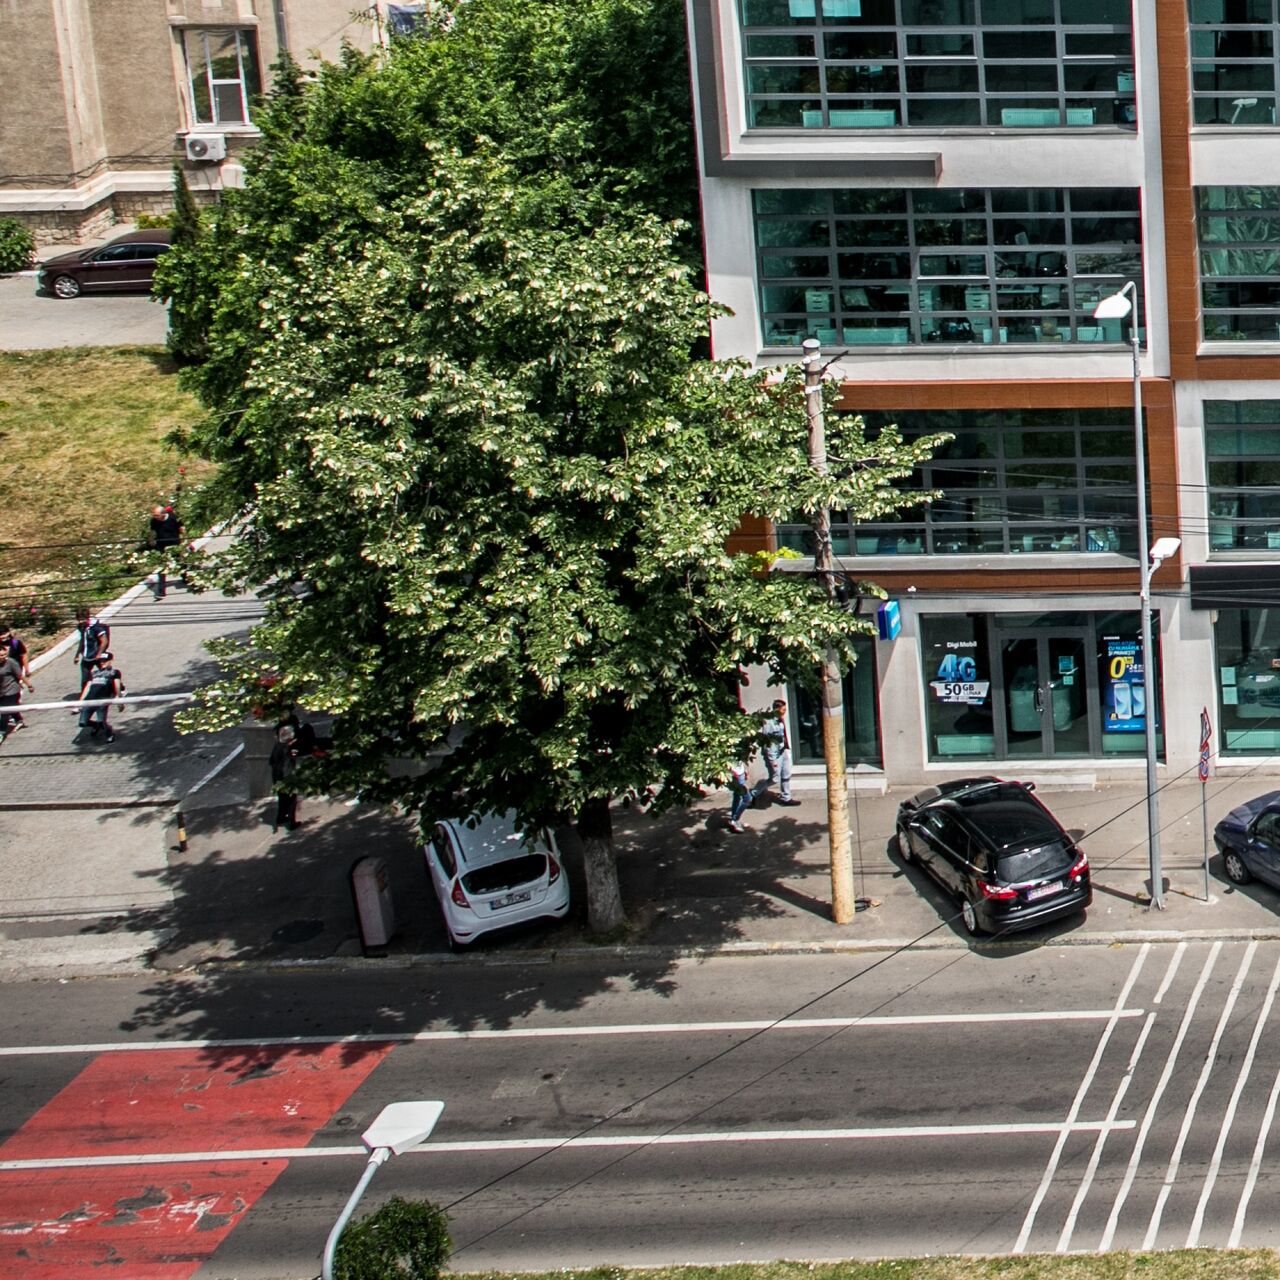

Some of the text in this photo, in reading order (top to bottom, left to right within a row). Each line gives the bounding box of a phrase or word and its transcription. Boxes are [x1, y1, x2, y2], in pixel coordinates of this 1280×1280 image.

[938, 653, 976, 682] 4G
[944, 683, 975, 696] 50 GB
